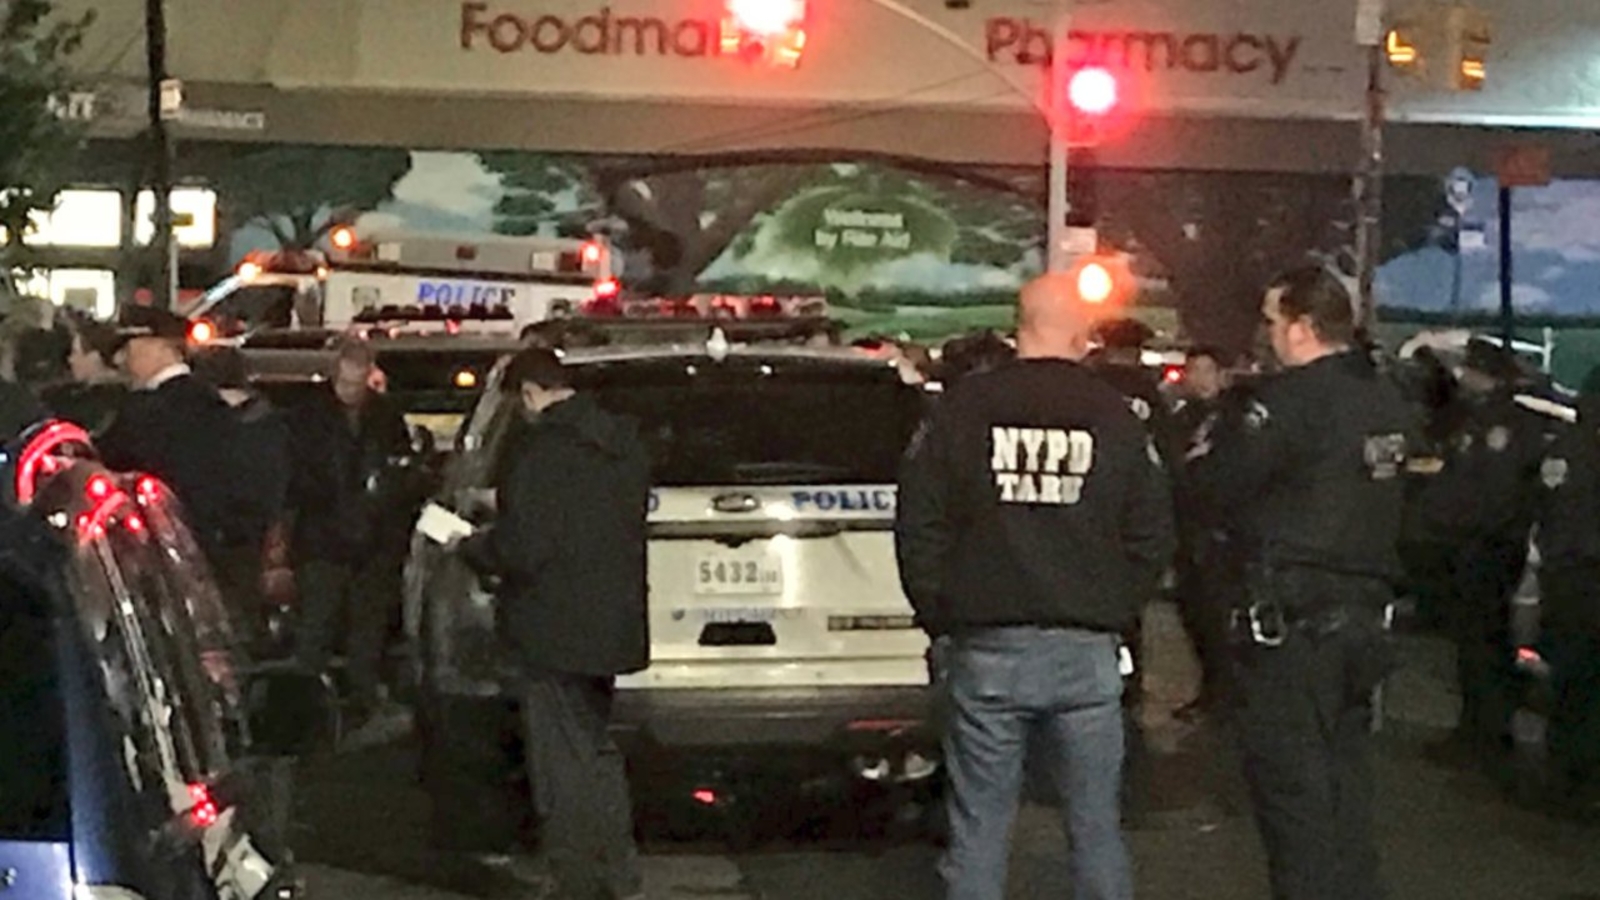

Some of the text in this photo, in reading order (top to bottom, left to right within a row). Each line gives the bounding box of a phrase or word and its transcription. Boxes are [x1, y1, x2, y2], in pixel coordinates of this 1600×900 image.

[418, 281, 516, 306] POLICE
[991, 426, 1093, 474] NYPD
[791, 489, 898, 512] POLIC
[699, 559, 758, 584] 5432
